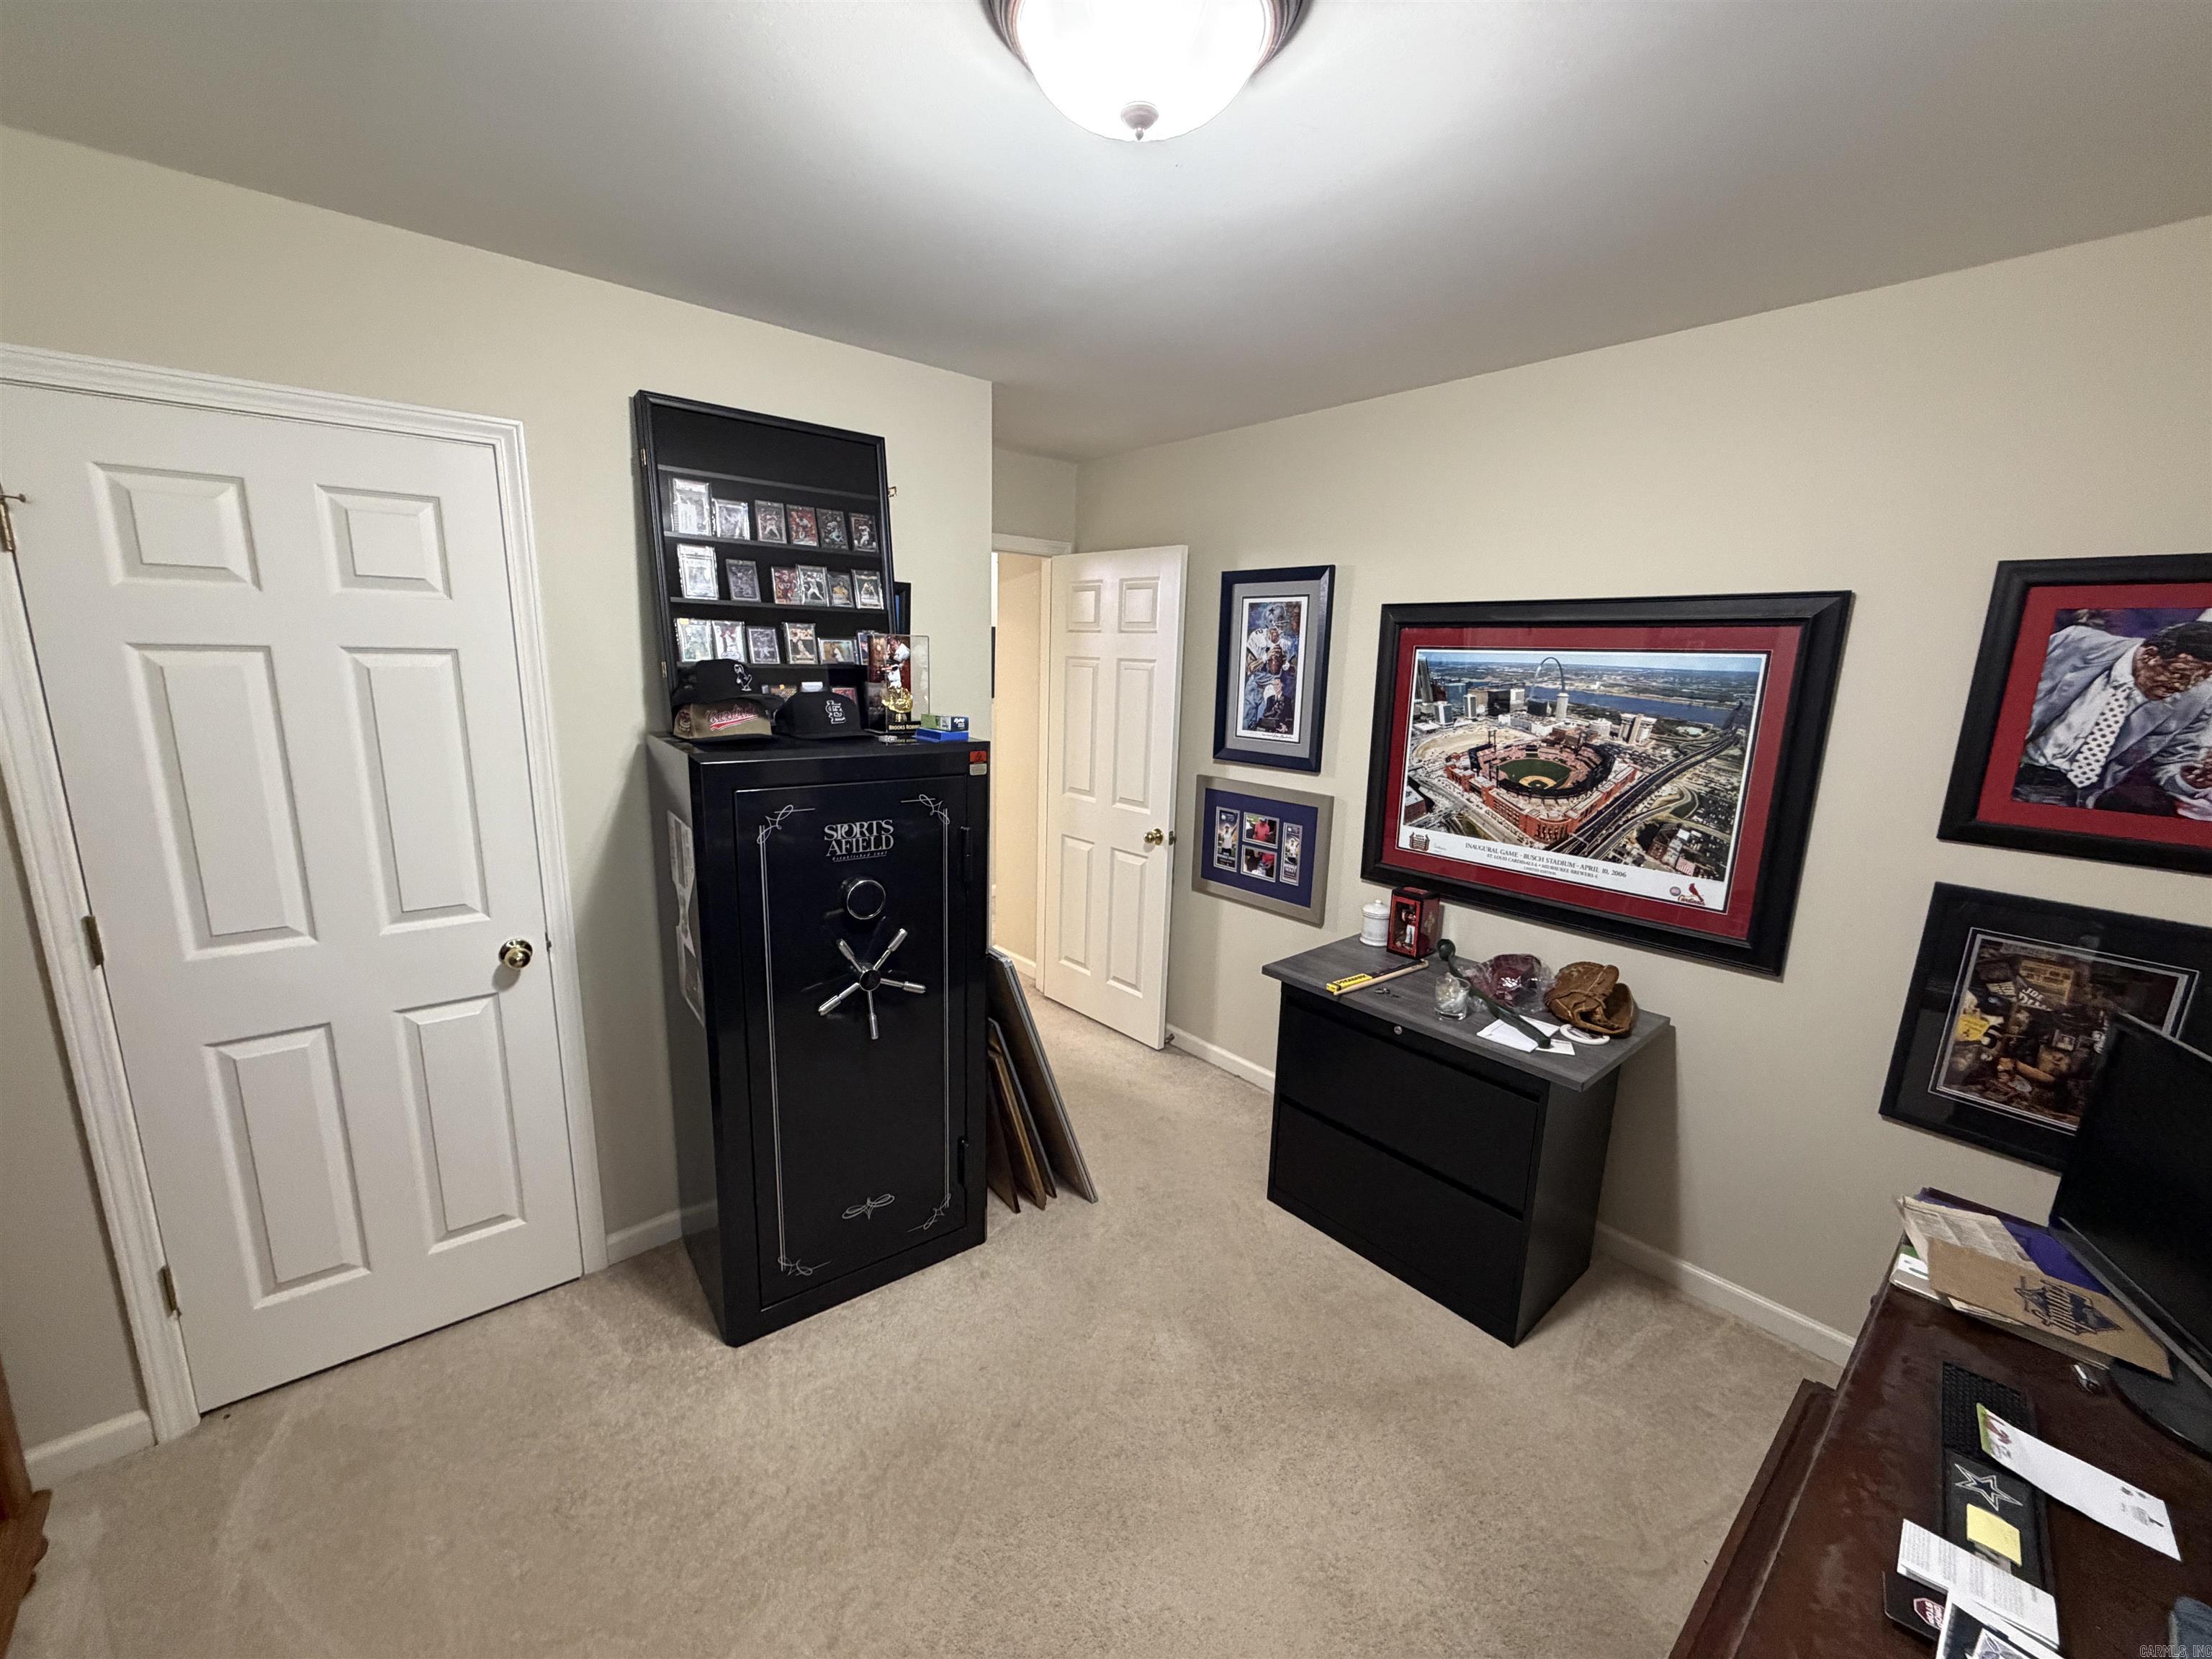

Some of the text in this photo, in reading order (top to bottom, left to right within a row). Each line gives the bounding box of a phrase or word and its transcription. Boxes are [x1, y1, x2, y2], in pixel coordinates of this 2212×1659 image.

[824, 819, 894, 841] SPORTS
[826, 833, 894, 856] AFIELD
[1465, 842, 1498, 854] INAUGURAL
[1500, 849, 1519, 858] GAME
[1523, 853, 1545, 863] BUSCH
[1545, 857, 1575, 868] STADIUM
[1580, 864, 1599, 873] APRIL
